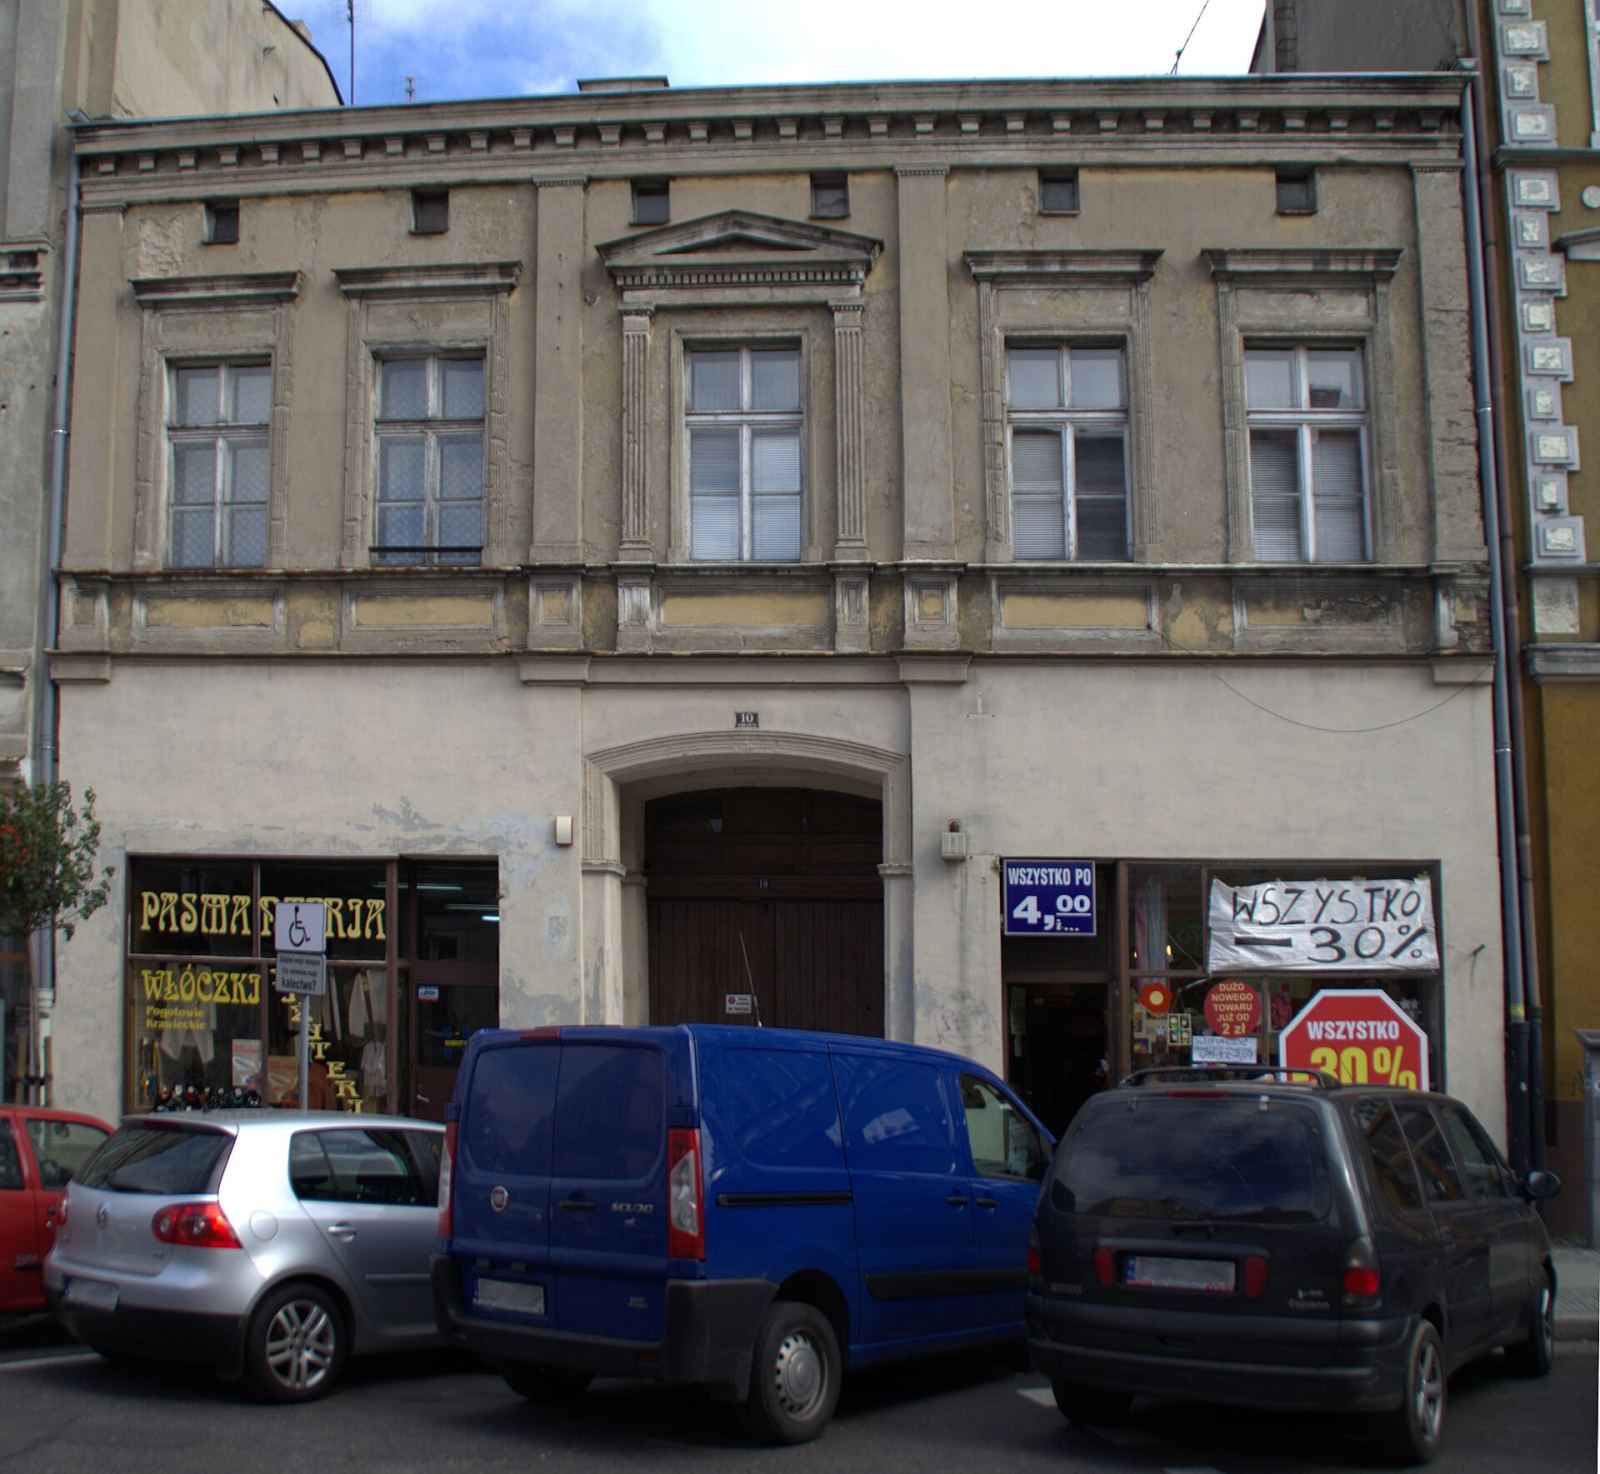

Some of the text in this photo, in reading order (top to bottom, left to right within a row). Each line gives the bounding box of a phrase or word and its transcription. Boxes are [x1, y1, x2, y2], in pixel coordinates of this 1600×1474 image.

[741, 713, 754, 723] 10
[1008, 867, 1092, 886] WSZYSTKO PO
[1232, 887, 1421, 926] WSZYSTKO
[1219, 982, 1245, 991] DUŻO
[1211, 992, 1253, 1001] NOWEGO
[146, 1005, 205, 1018] Pogotowie
[1213, 1003, 1252, 1011] TOWARU
[1236, 1013, 1250, 1021] OD
[1222, 1022, 1230, 1035] 2
[1306, 1020, 1400, 1040] WSZYSTKO
